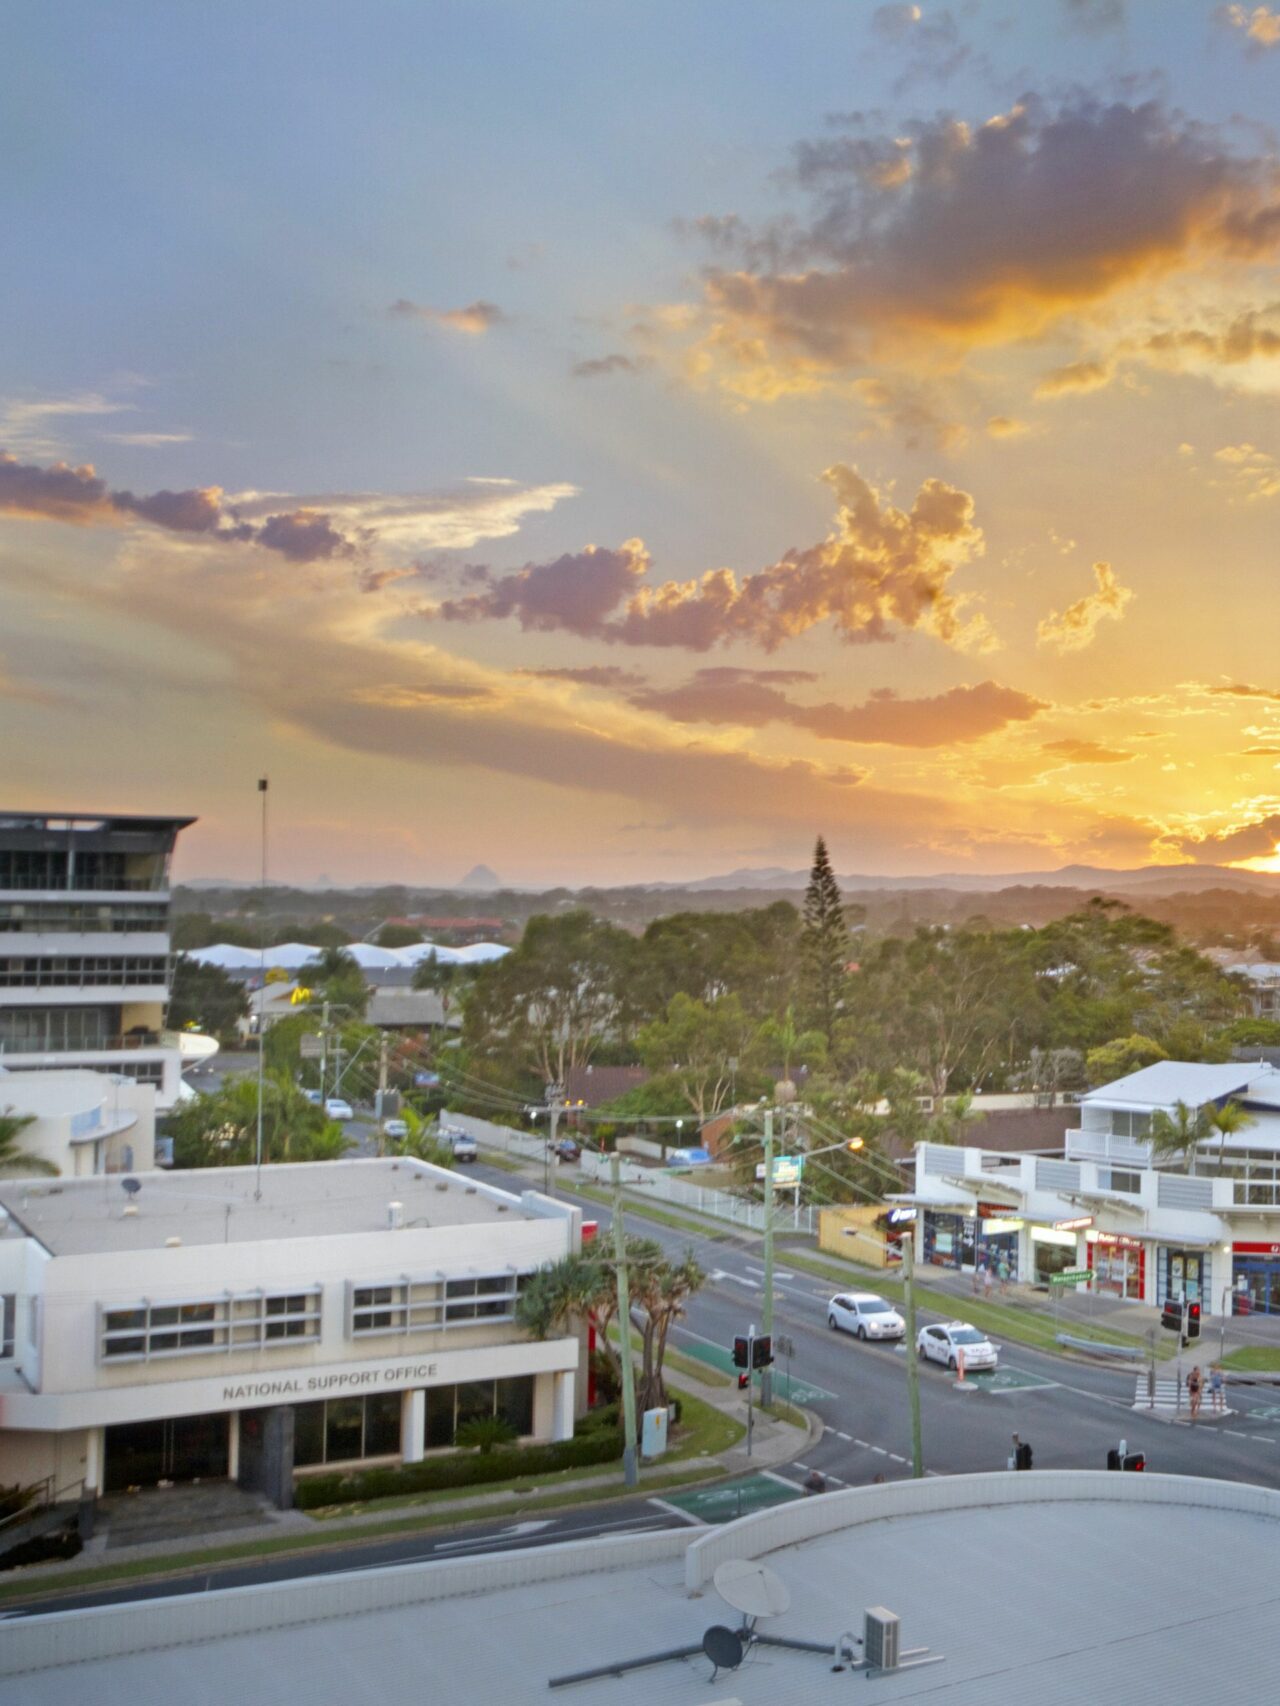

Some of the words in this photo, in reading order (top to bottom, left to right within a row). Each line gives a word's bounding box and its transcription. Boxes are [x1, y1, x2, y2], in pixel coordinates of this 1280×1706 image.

[223, 1379, 303, 1400] NATIONAL
[307, 1369, 380, 1391] SUPPORT
[384, 1363, 438, 1381] OFFICE
